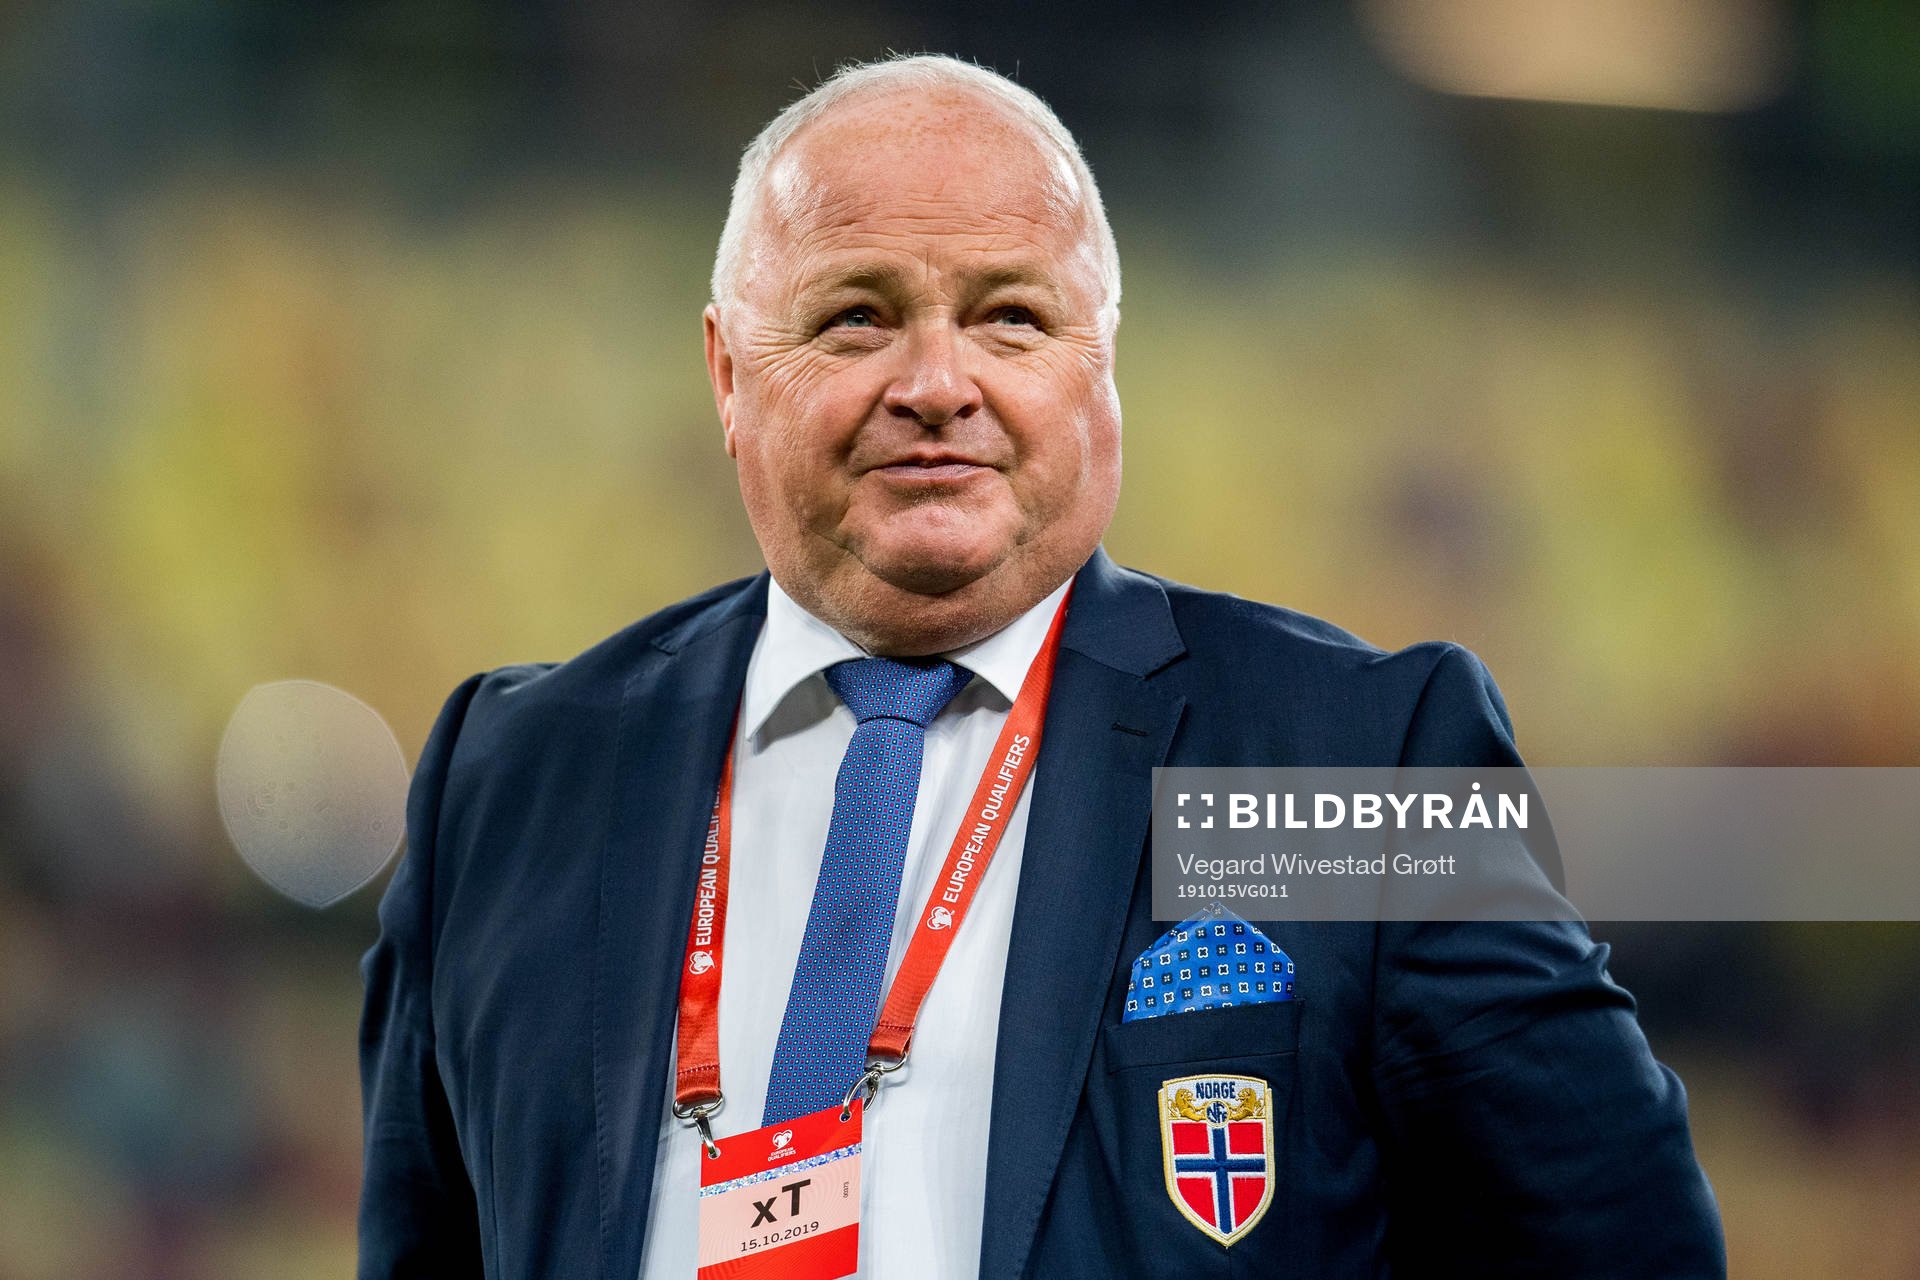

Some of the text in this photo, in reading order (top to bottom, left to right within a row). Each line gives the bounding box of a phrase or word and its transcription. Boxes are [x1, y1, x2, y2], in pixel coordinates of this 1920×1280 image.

[942, 733, 1030, 903] EUROPEAN QUALIFIERS
[696, 868, 718, 946] EUROPEAN
[1195, 1082, 1236, 1099] NORGE
[750, 1179, 811, 1229] xT
[740, 1221, 819, 1252] 15.10.2019
